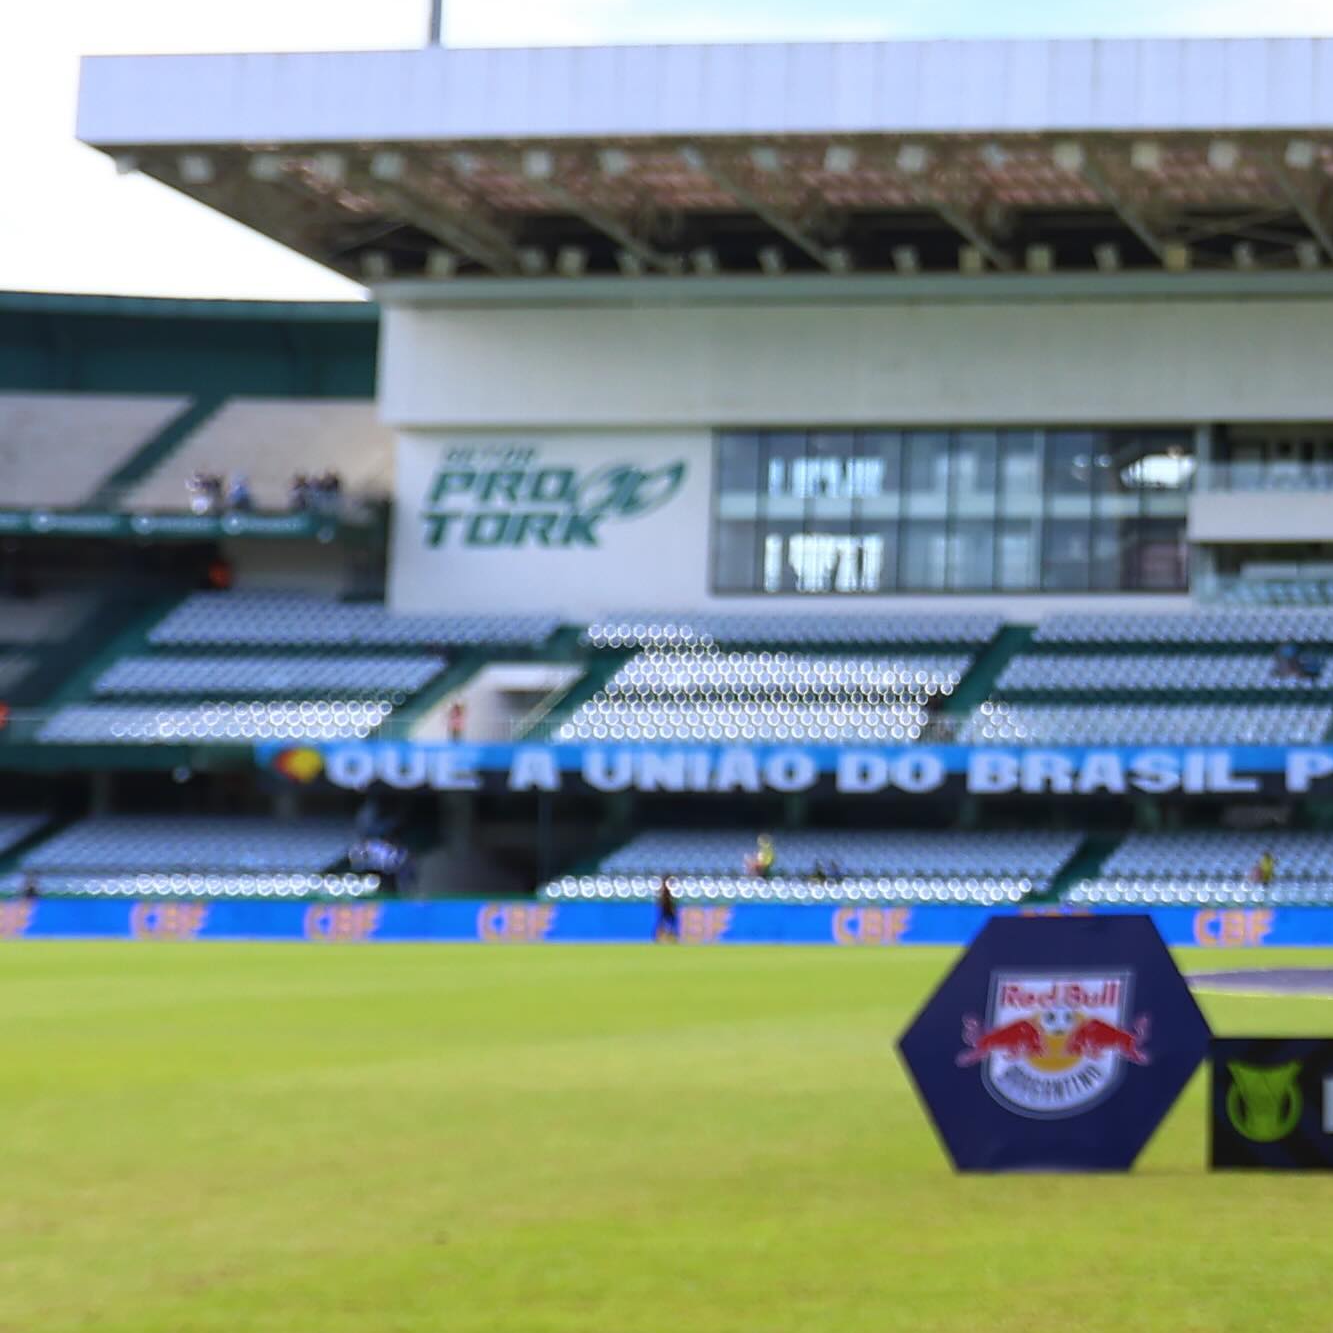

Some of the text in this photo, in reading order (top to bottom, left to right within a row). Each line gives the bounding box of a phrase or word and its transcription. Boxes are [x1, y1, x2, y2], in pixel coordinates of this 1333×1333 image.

[429, 468, 577, 503] PRO
[423, 512, 602, 547] TORK
[326, 749, 483, 791] QUE
[507, 750, 561, 792] A
[581, 744, 817, 793] UNIÃO
[835, 750, 947, 793] DO
[966, 751, 1261, 794] BRASIL
[1193, 909, 1272, 945] CBF
[1001, 981, 1120, 1008] Red Bull
